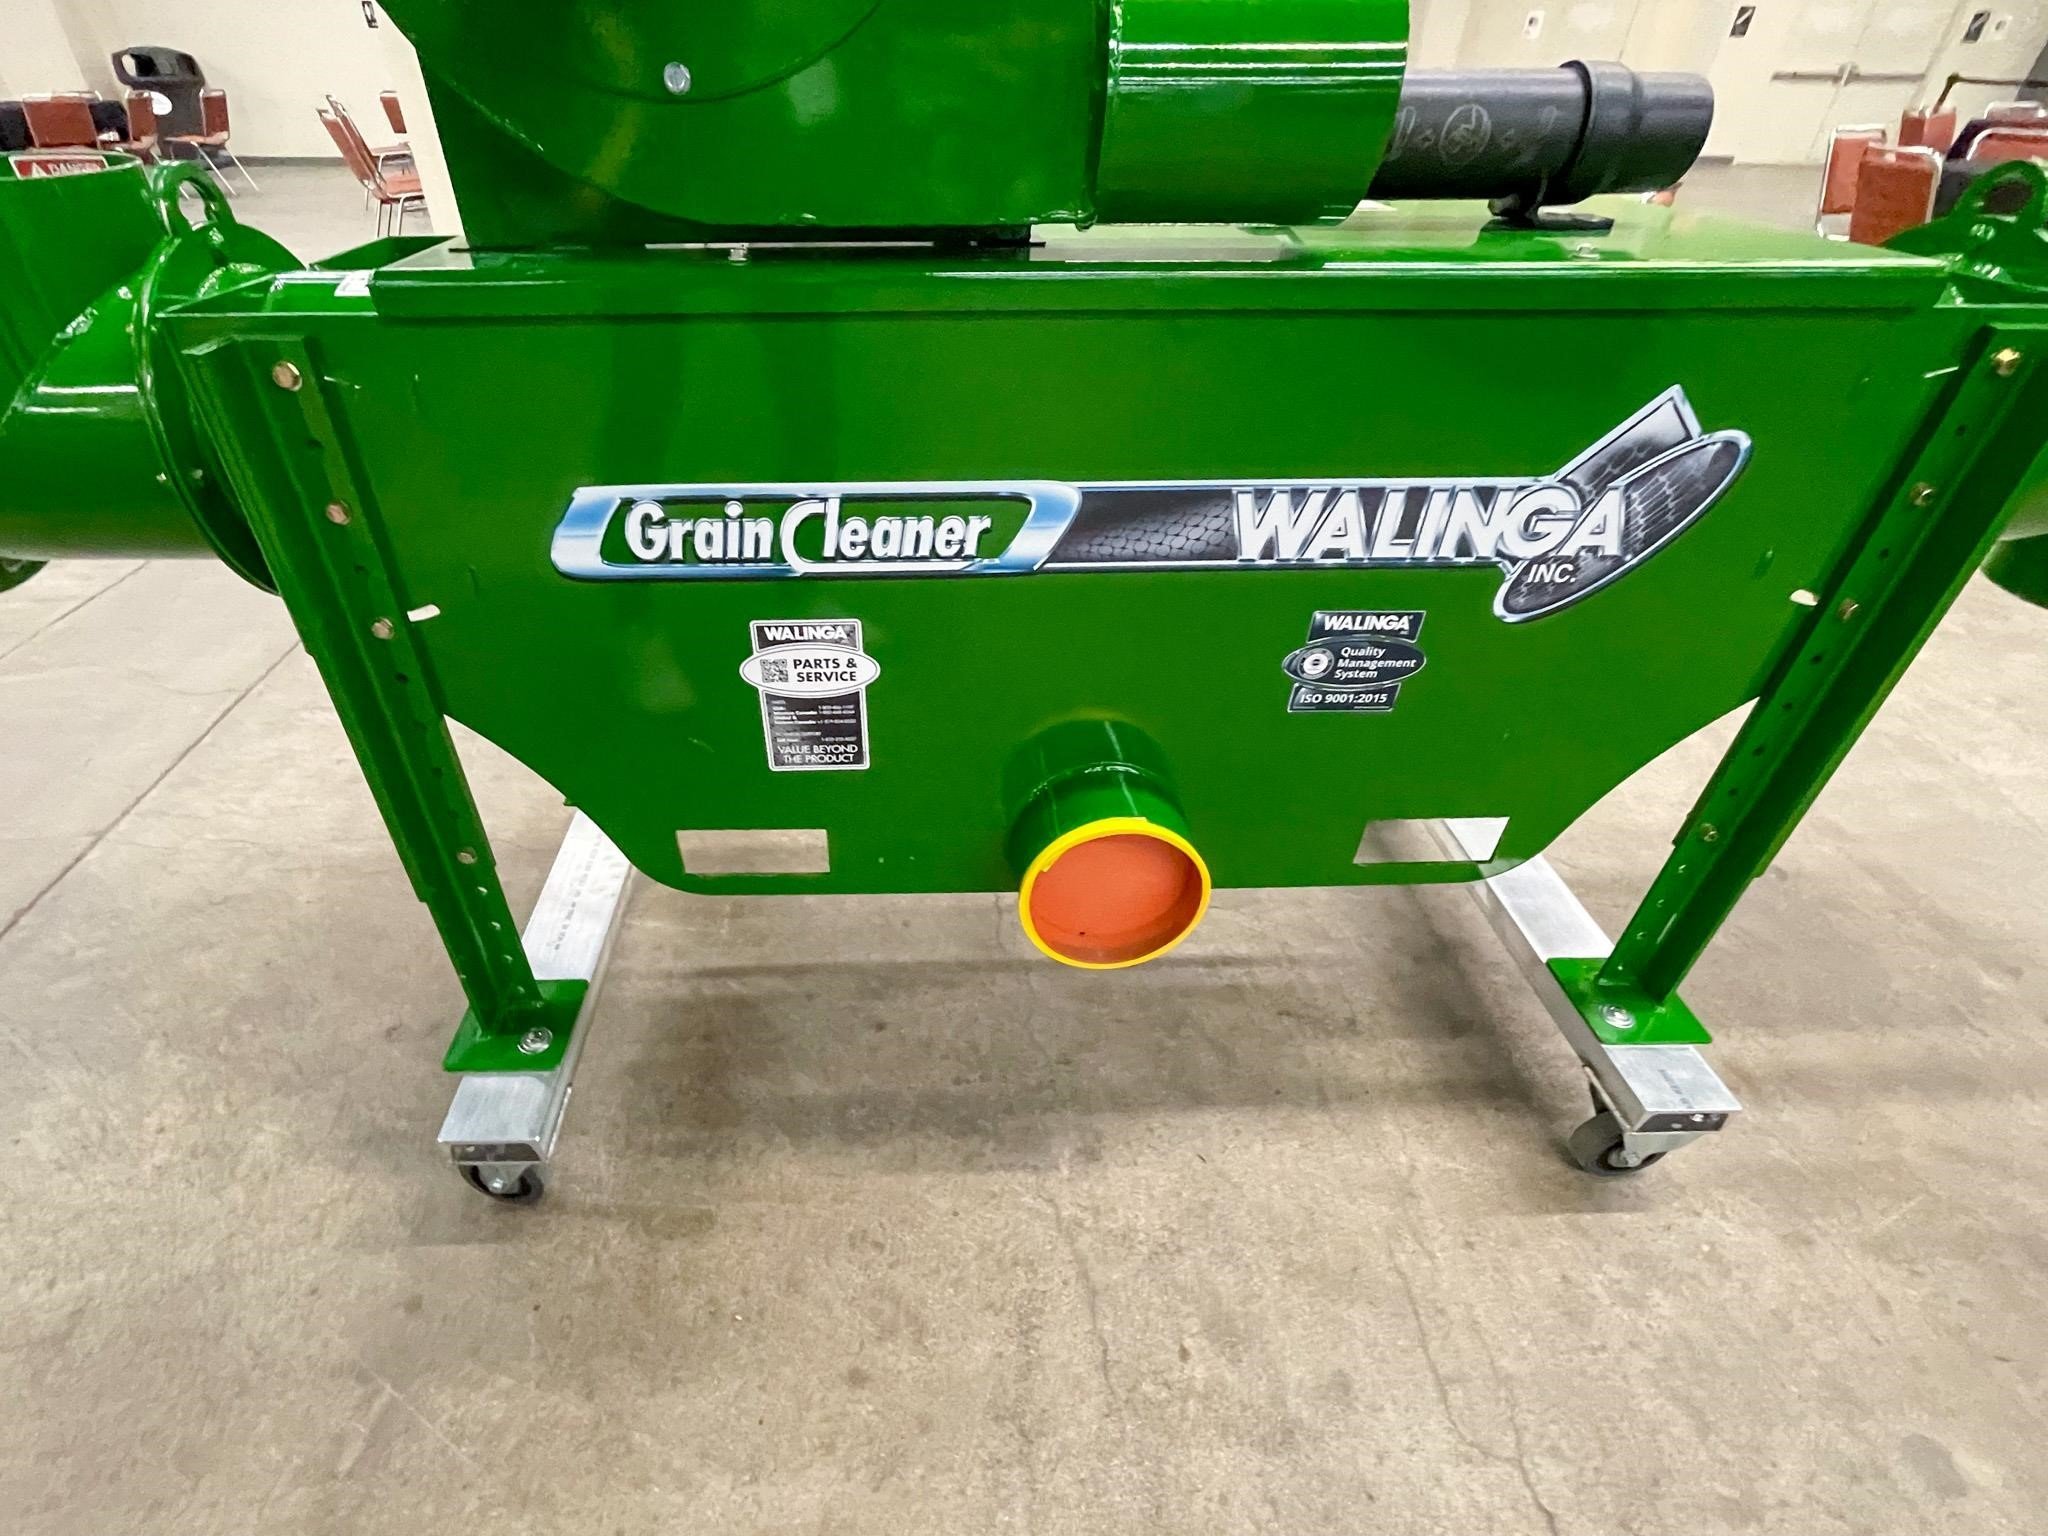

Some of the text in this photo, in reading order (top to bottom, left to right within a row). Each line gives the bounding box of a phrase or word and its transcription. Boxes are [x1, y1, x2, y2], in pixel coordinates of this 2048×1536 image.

[1235, 484, 1624, 561] WALINGA
[625, 496, 992, 569] Grain Cleaner
[1527, 564, 1577, 584] INC.
[1324, 615, 1410, 631] WALINGA
[763, 625, 848, 641] WALINGA
[1341, 646, 1386, 659] Quality
[793, 657, 858, 669] PARTS &
[1337, 658, 1417, 670] Management
[796, 670, 858, 682] SERVICE
[1333, 669, 1378, 681] System
[1300, 693, 1388, 704] ISO 9001:2015
[777, 744, 859, 754] VALUE BEYOND
[784, 754, 855, 764] THE PRODUCT
